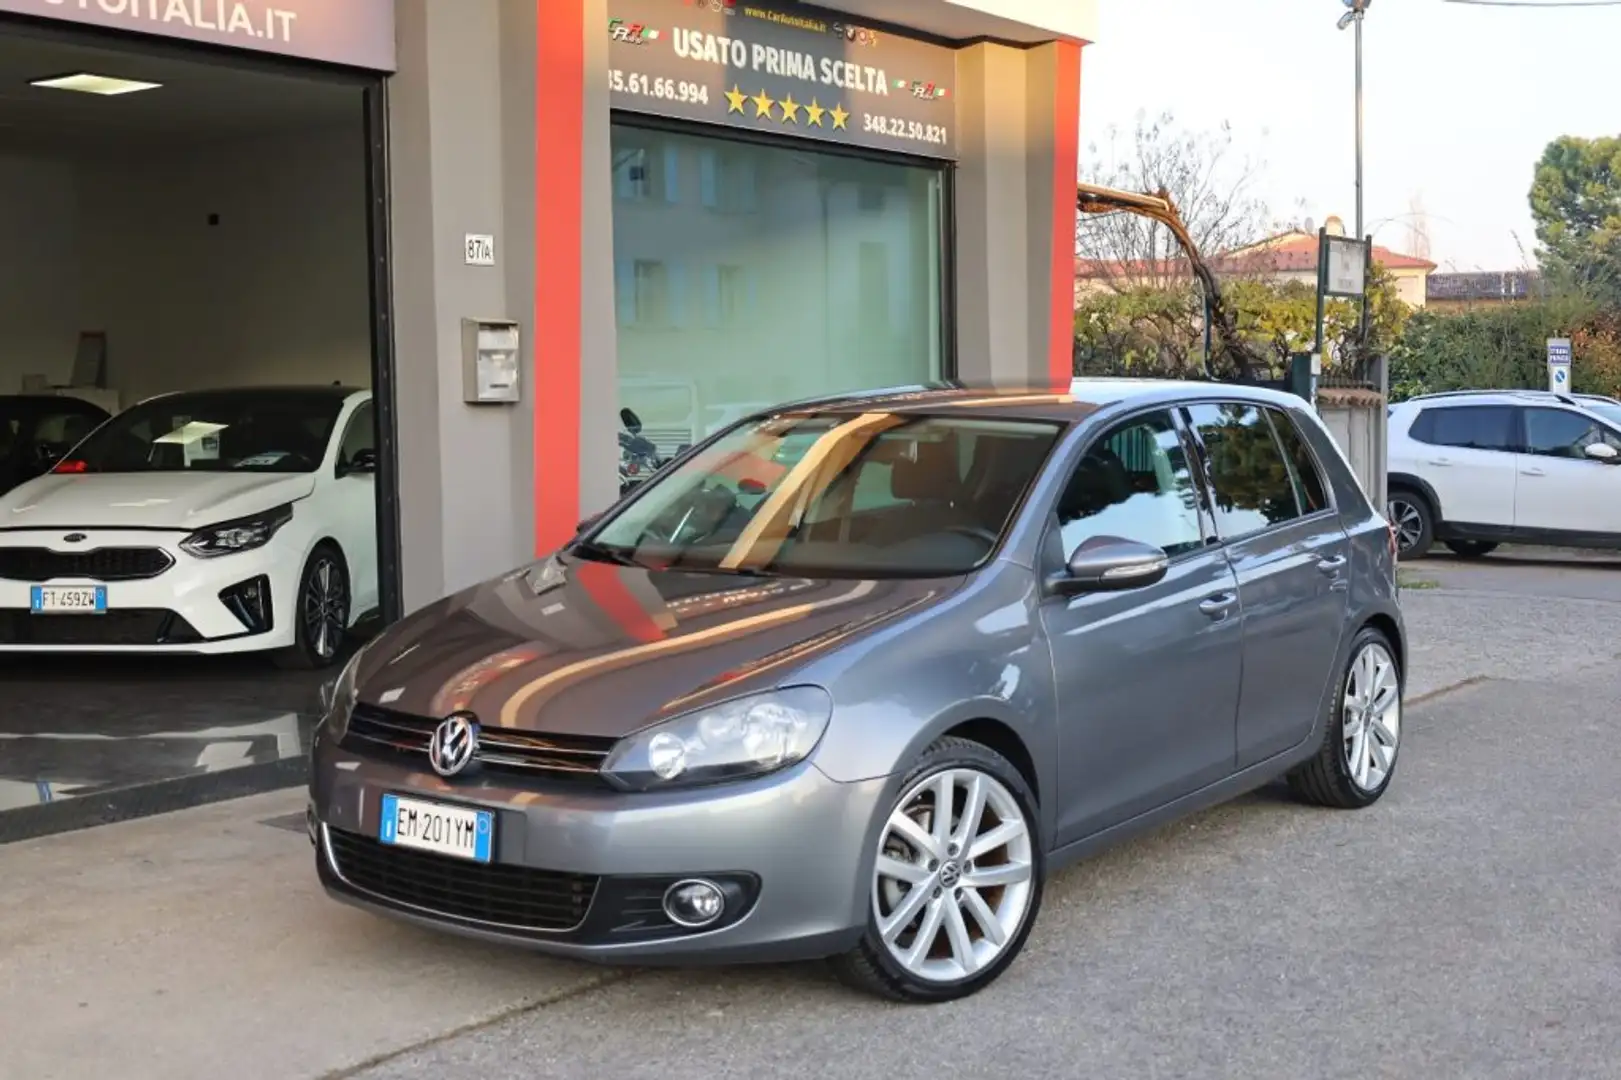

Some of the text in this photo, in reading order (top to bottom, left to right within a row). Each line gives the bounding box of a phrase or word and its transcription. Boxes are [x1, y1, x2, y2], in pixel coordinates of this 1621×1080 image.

[44, 0, 297, 41] ITALIA.IT
[673, 26, 747, 69] USATO
[752, 44, 816, 81] PRIMA
[820, 57, 888, 96] SCELTA
[863, 112, 947, 145] 348.22.50.821
